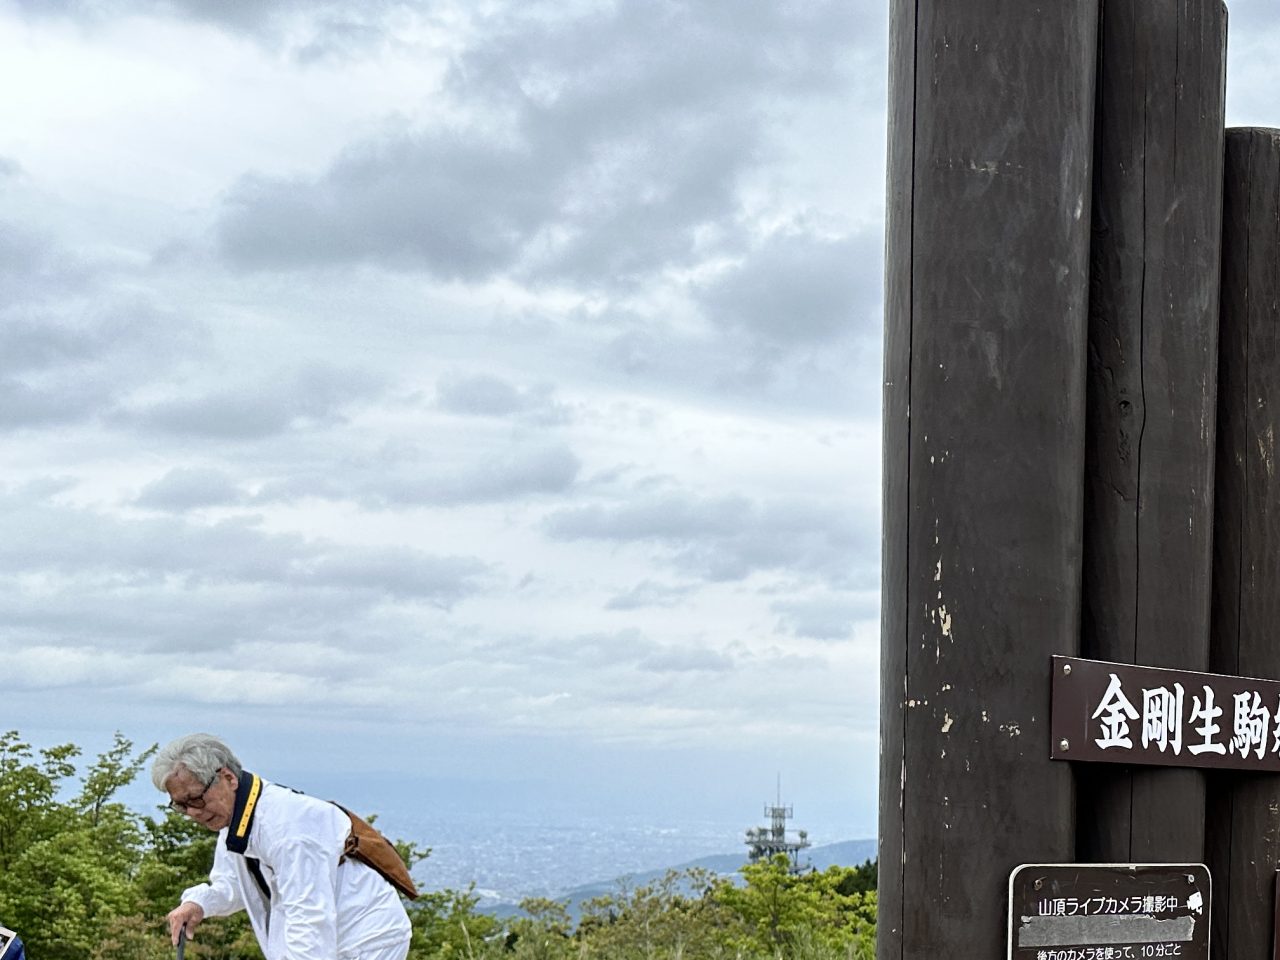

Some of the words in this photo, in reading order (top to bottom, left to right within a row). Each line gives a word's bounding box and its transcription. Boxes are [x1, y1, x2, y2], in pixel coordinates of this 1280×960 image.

[1038, 895, 1178, 916] 山頂ライブカメラ撮影中
